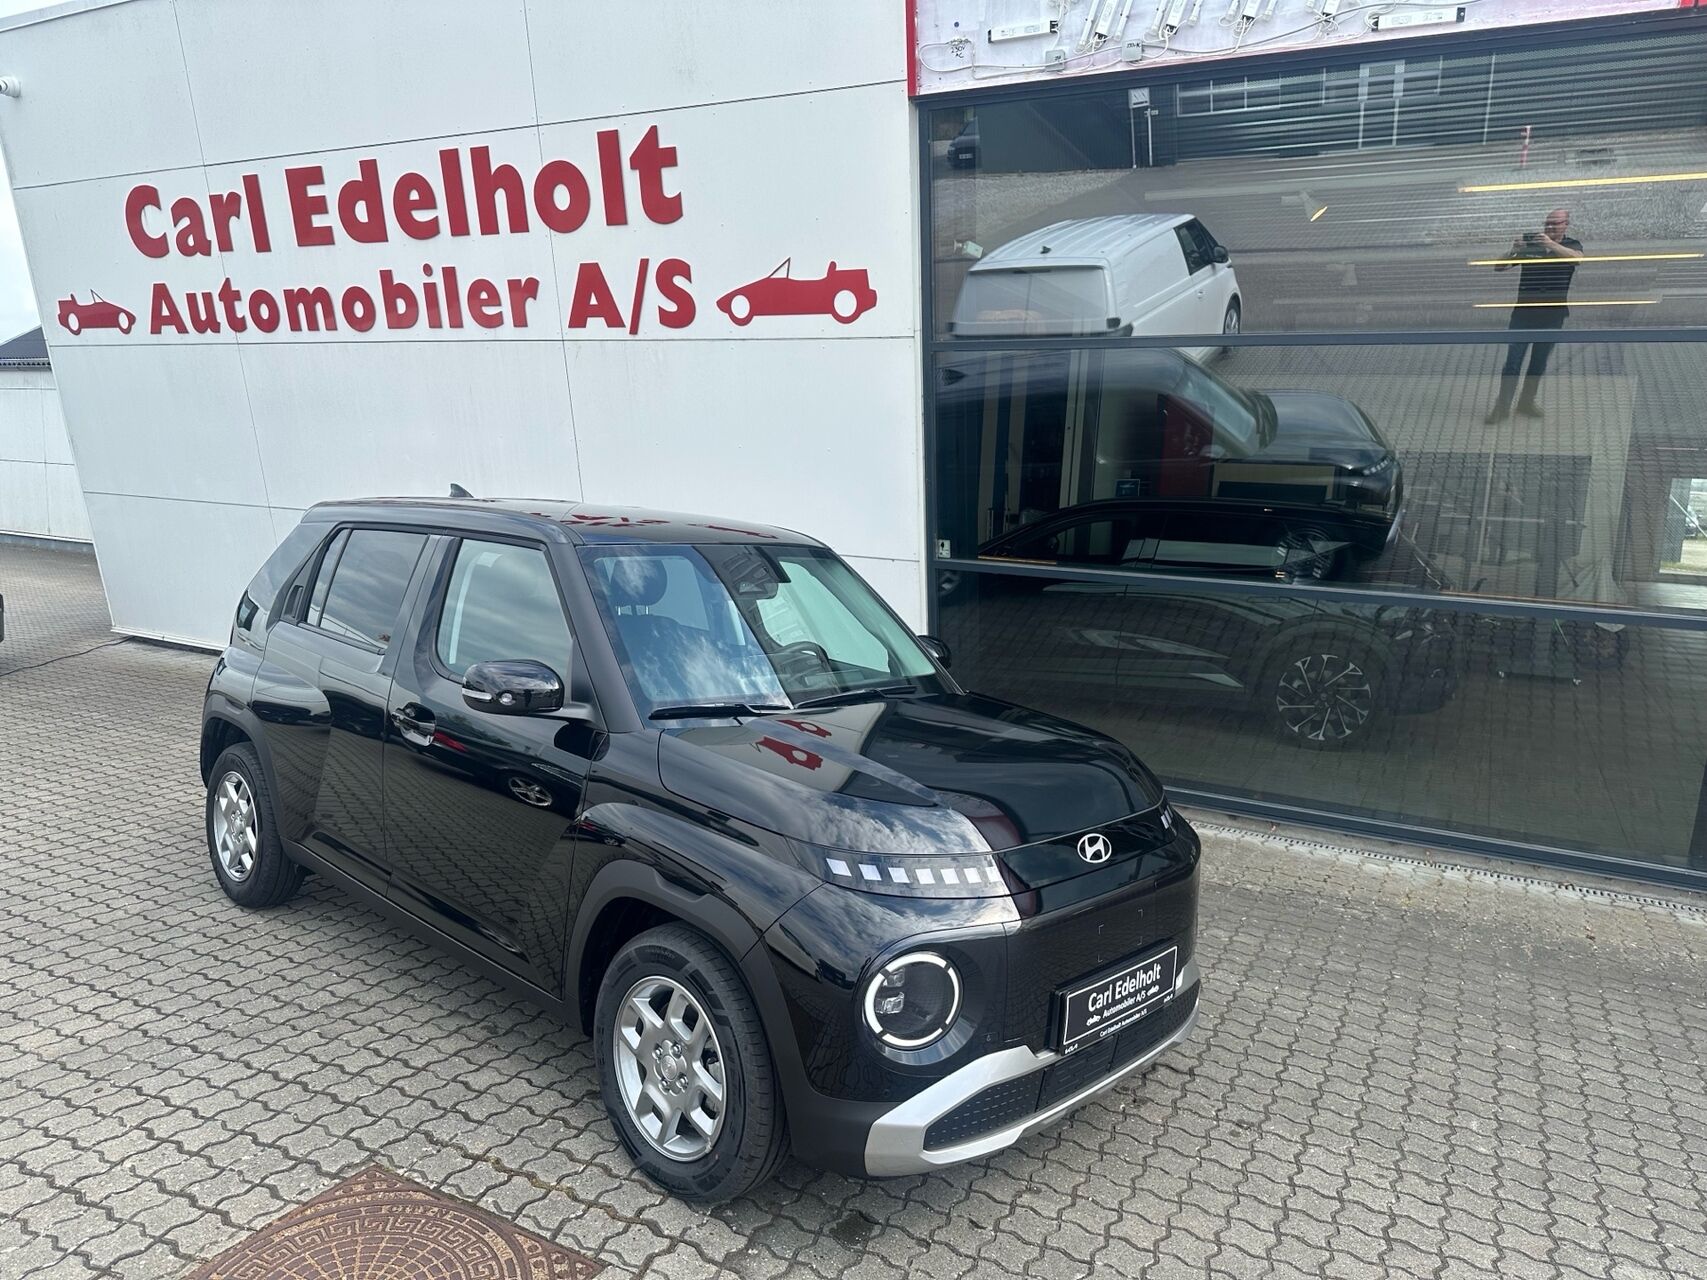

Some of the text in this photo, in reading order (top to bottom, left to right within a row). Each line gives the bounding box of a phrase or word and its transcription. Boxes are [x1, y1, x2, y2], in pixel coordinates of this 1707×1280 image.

[125, 125, 684, 258] Carl Edelholt
[150, 257, 696, 335] Automobiler A/S
[1088, 963, 1162, 1012] Carl Edelholt
